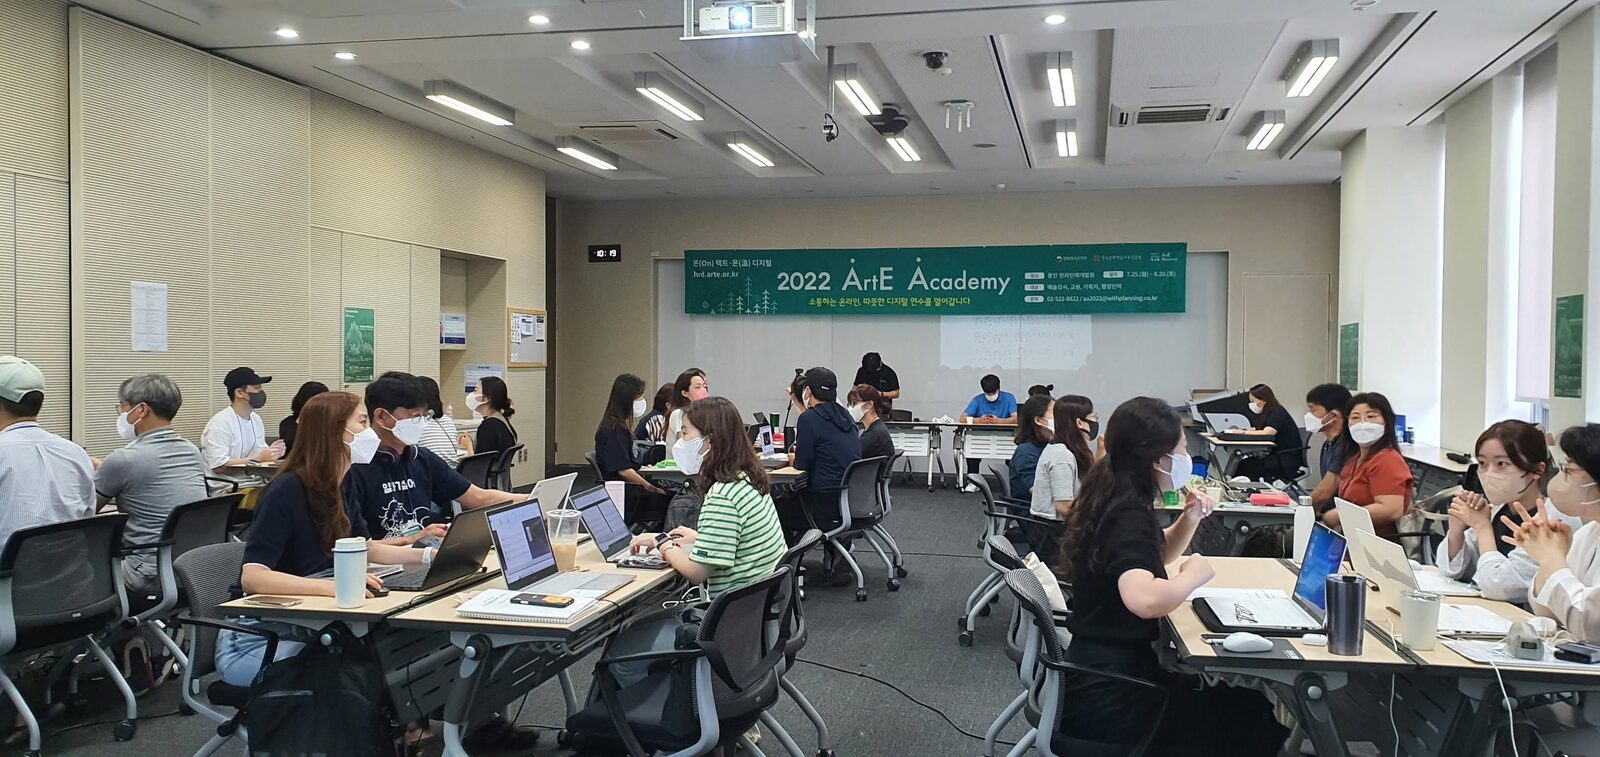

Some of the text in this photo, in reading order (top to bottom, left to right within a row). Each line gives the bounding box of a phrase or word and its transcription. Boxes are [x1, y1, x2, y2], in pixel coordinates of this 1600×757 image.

[752, 259, 772, 268] 디지털
[777, 271, 831, 291] 2022
[808, 297, 837, 307] 소통하는
[863, 297, 885, 306] 따뜻한
[886, 297, 909, 306] 디지털
[909, 297, 932, 306] 연수를
